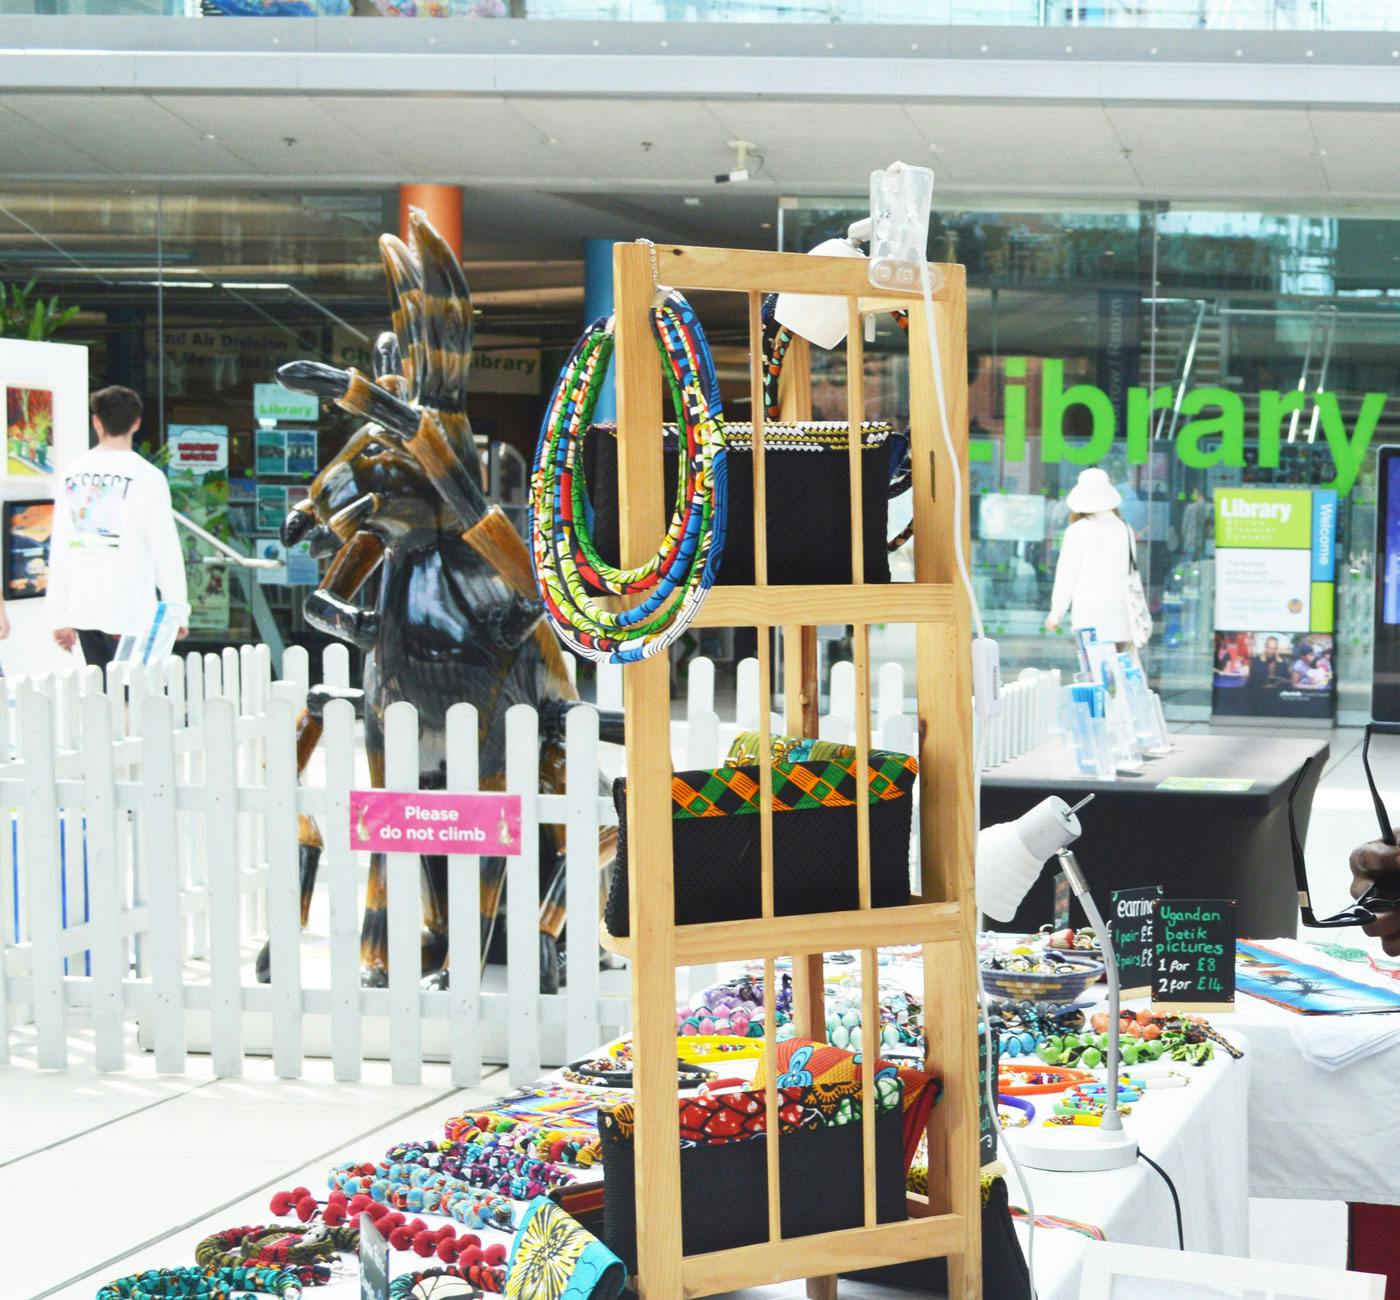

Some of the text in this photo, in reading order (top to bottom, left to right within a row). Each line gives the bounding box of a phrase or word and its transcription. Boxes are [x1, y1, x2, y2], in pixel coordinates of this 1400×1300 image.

[469, 353, 537, 375] ibrary
[260, 403, 313, 417] Library
[1221, 498, 1292, 523] Library
[1319, 503, 1333, 566] Welcome
[405, 805, 459, 821] Please
[380, 825, 486, 841] do not climb
[1161, 906, 1221, 927] Ugandan
[1120, 930, 1139, 948] pair
[1165, 926, 1208, 941] batik
[1156, 942, 1224, 955] pictures
[1120, 954, 1141, 970] pairs
[1158, 957, 1216, 973] 1 for £8
[1158, 976, 1224, 993] 2 for £14
